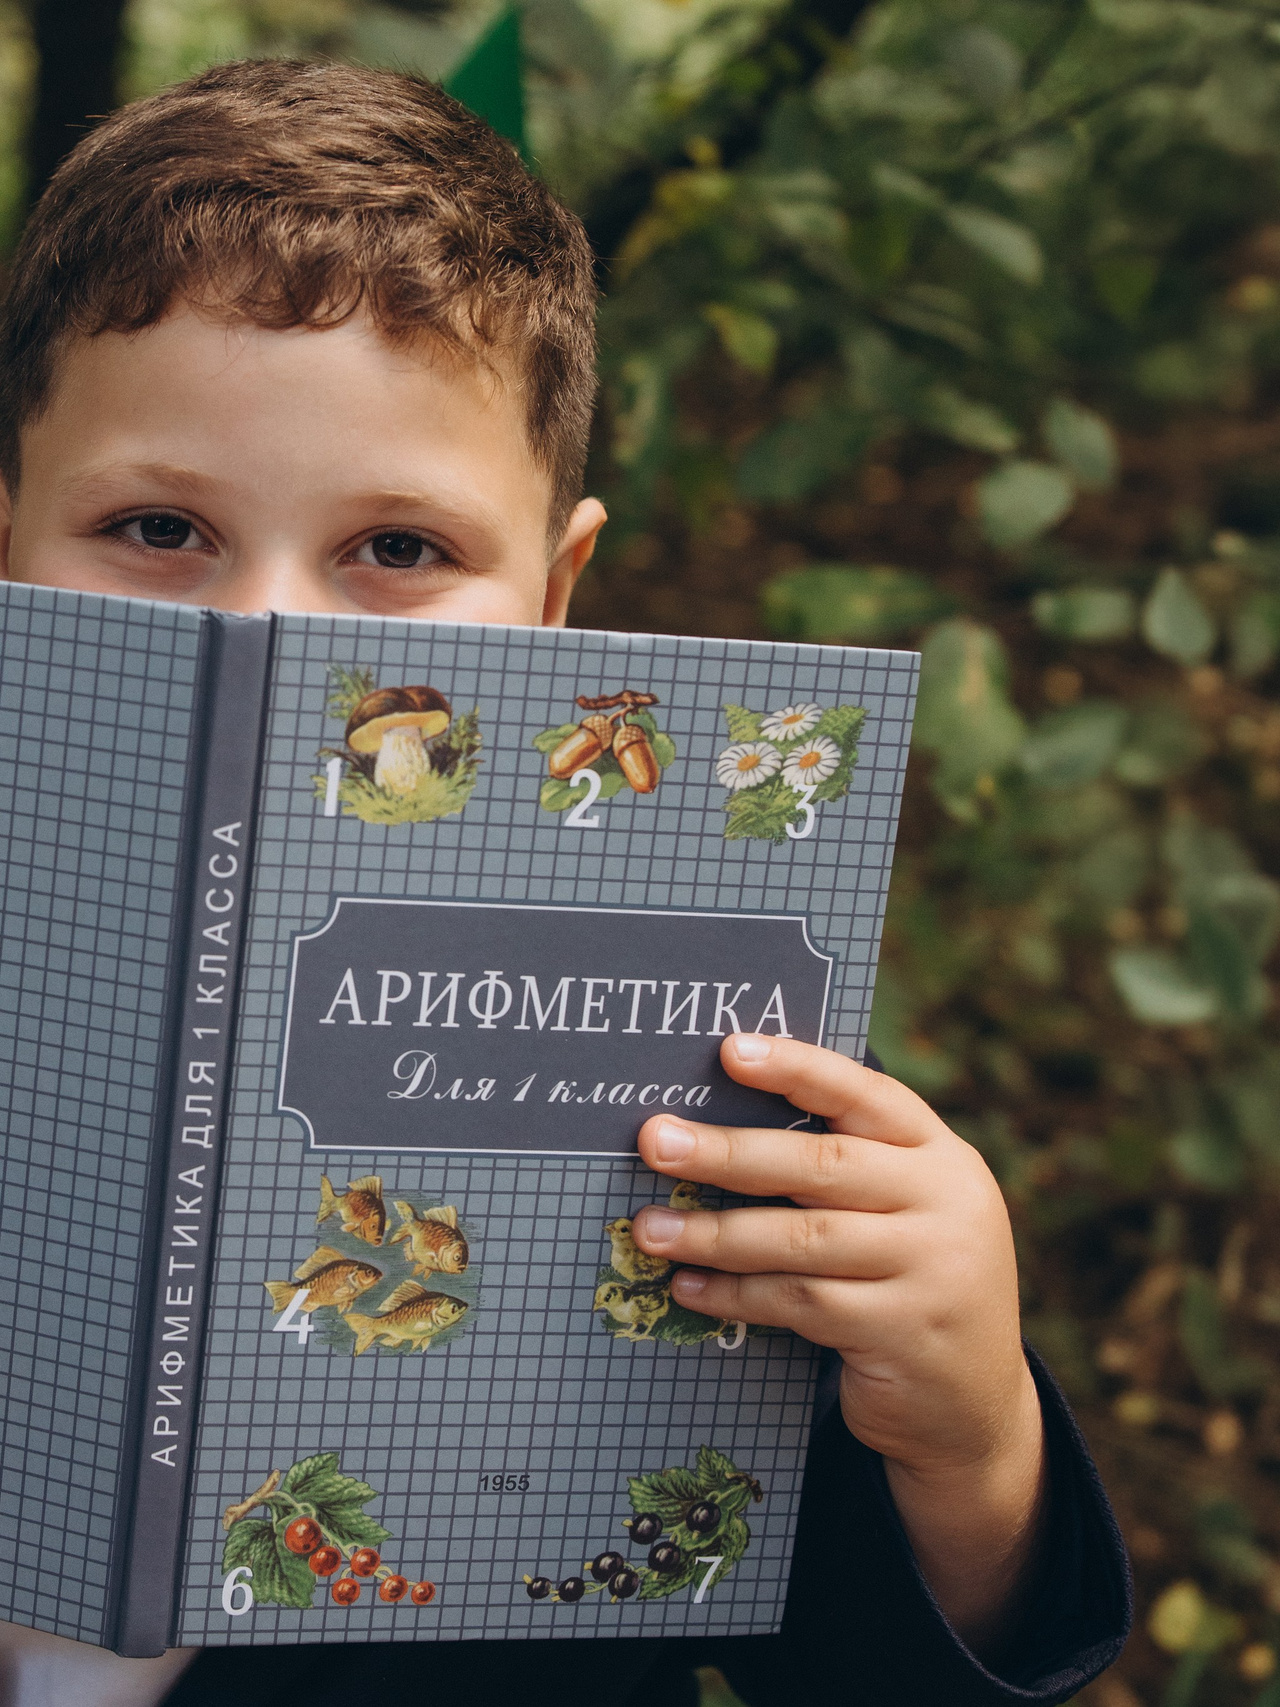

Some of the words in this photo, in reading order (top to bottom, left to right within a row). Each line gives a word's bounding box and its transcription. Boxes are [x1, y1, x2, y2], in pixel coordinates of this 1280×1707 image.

[322, 757, 342, 817] 1
[564, 768, 603, 828] 2
[785, 783, 819, 840] 3
[195, 821, 242, 1004] КЛАССА
[319, 967, 794, 1039] АРИФМЕТИКА
[192, 1028, 220, 1040] 1
[181, 1061, 217, 1149] ДЛЯ
[386, 1050, 498, 1101] Для
[513, 1073, 538, 1102] 1
[546, 1079, 713, 1108] класса
[151, 1164, 206, 1468] АРИФМЕТИКА
[272, 1288, 315, 1345] 4
[478, 1473, 532, 1493] 1955
[220, 1565, 255, 1616] 6
[691, 1555, 725, 1604] 7
